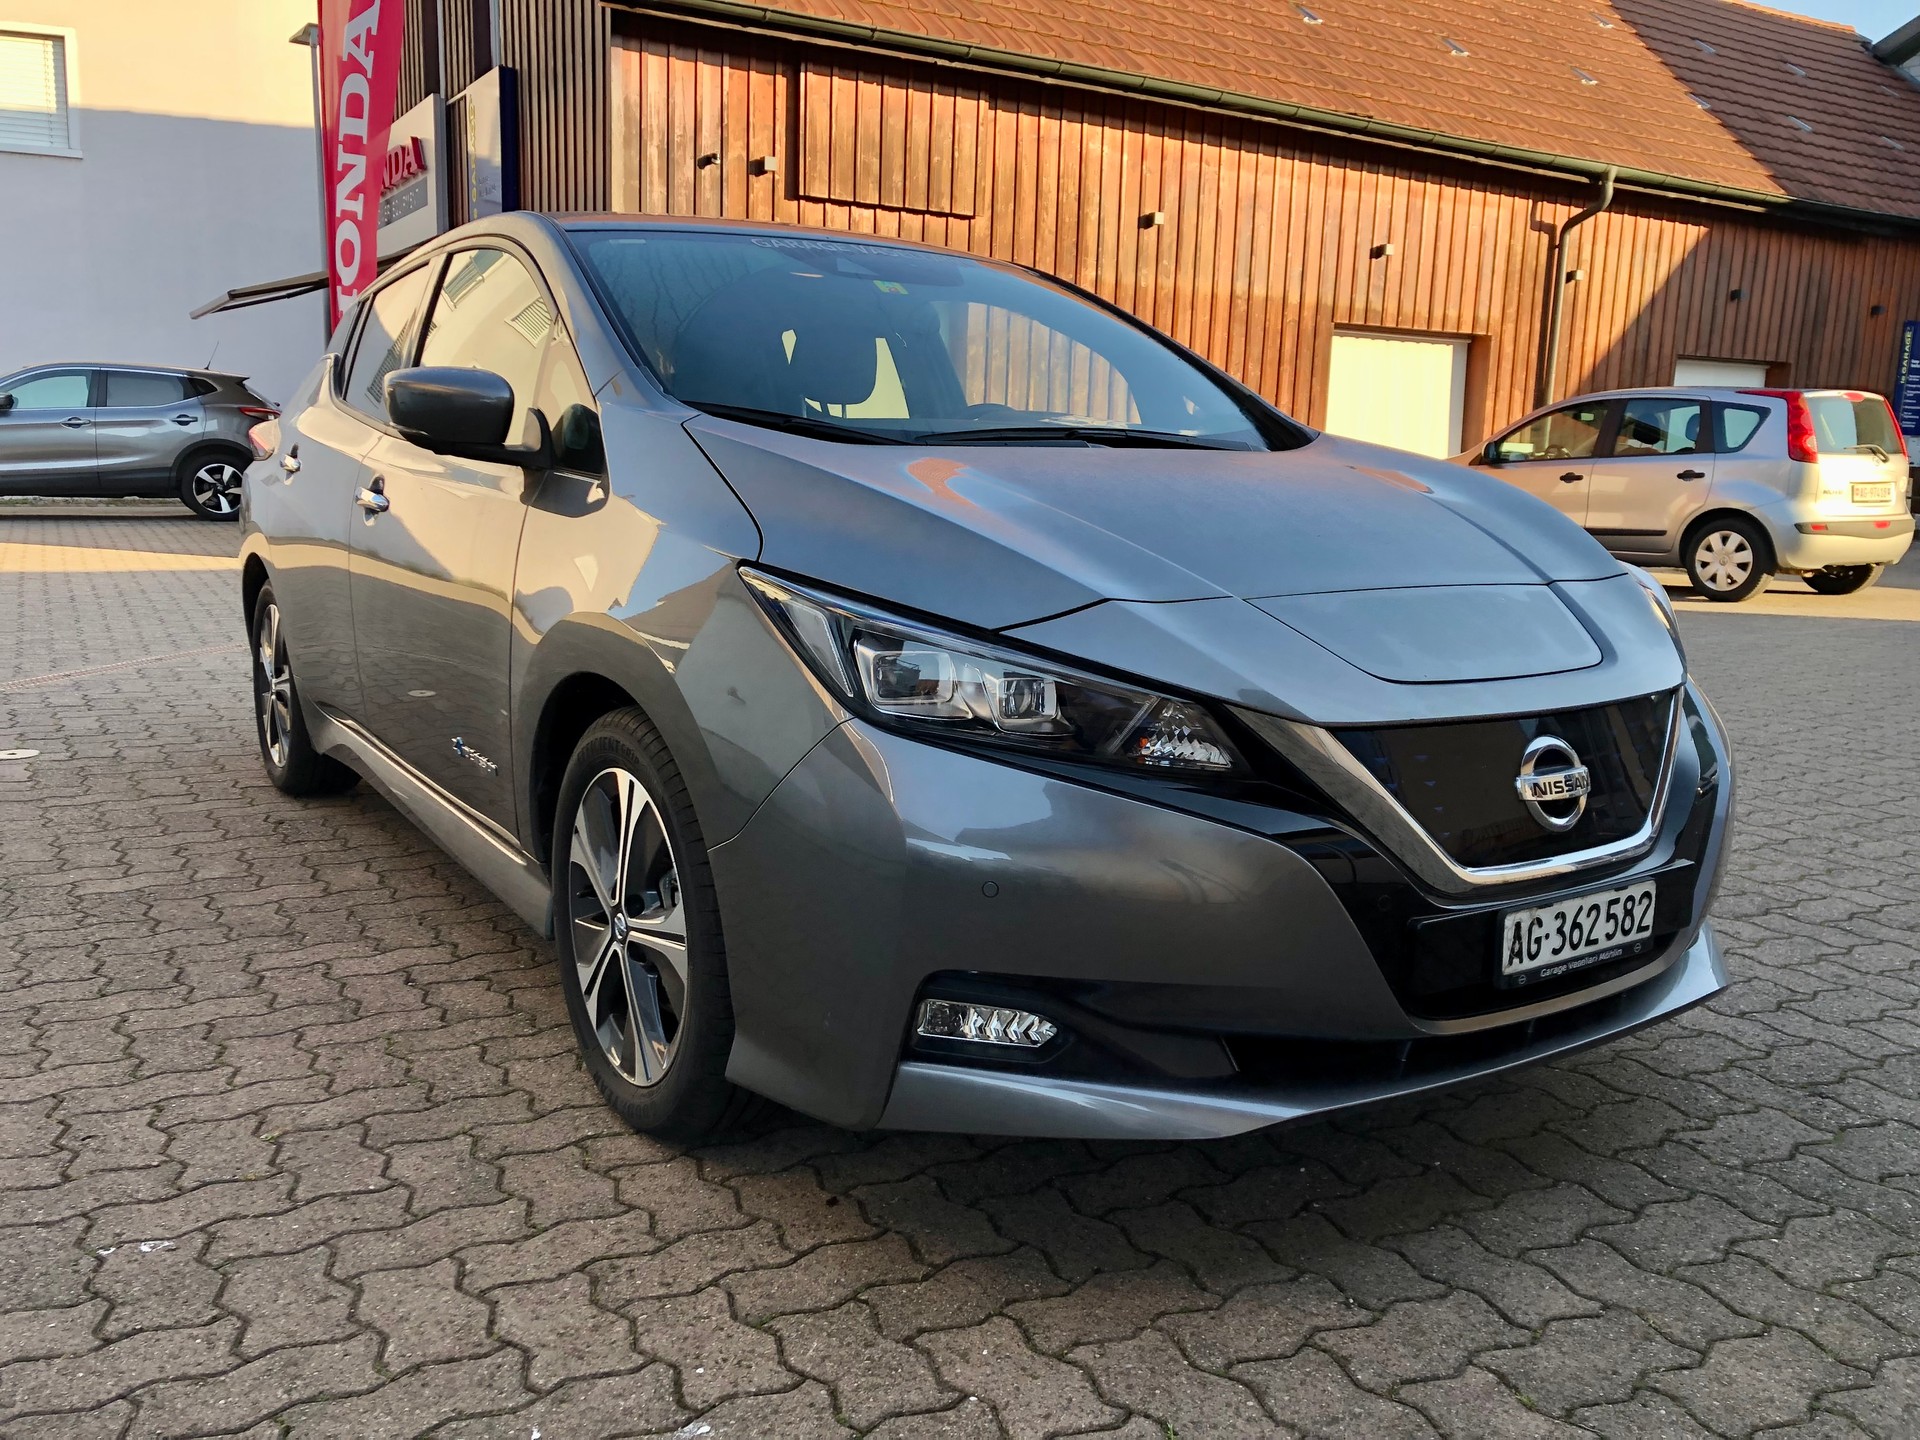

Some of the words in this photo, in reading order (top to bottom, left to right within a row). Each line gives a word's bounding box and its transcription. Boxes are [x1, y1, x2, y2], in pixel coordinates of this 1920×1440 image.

[751, 238, 851, 251] GARAGE
[1532, 774, 1589, 798] NISSAN
[1540, 965, 1567, 977] Garage
